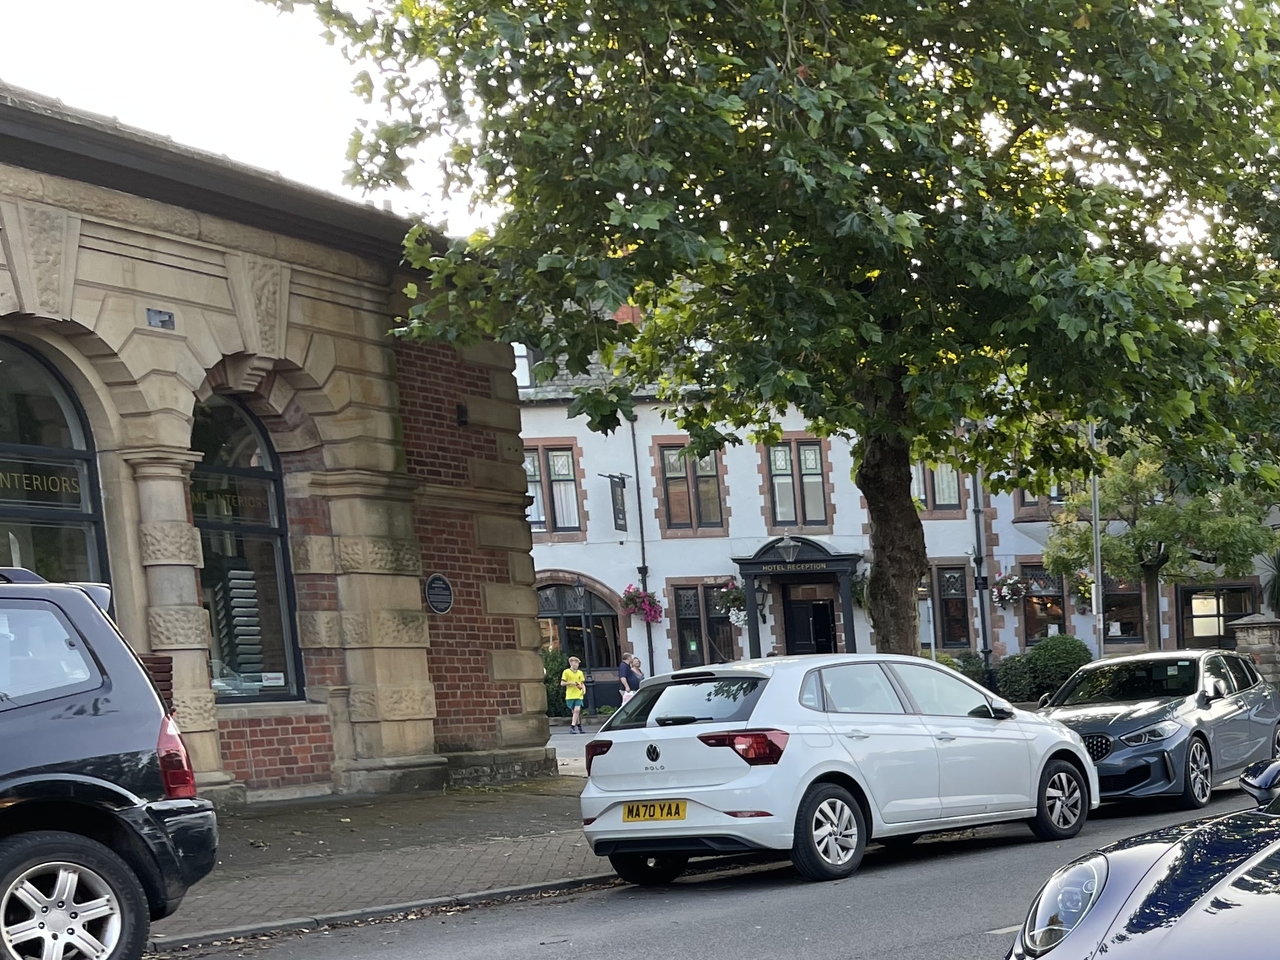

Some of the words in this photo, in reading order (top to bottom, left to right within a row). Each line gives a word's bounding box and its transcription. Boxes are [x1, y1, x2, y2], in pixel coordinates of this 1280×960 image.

[0, 472, 80, 494] NTERIORS
[627, 804, 655, 819] MA70
[659, 803, 680, 817] YAA
